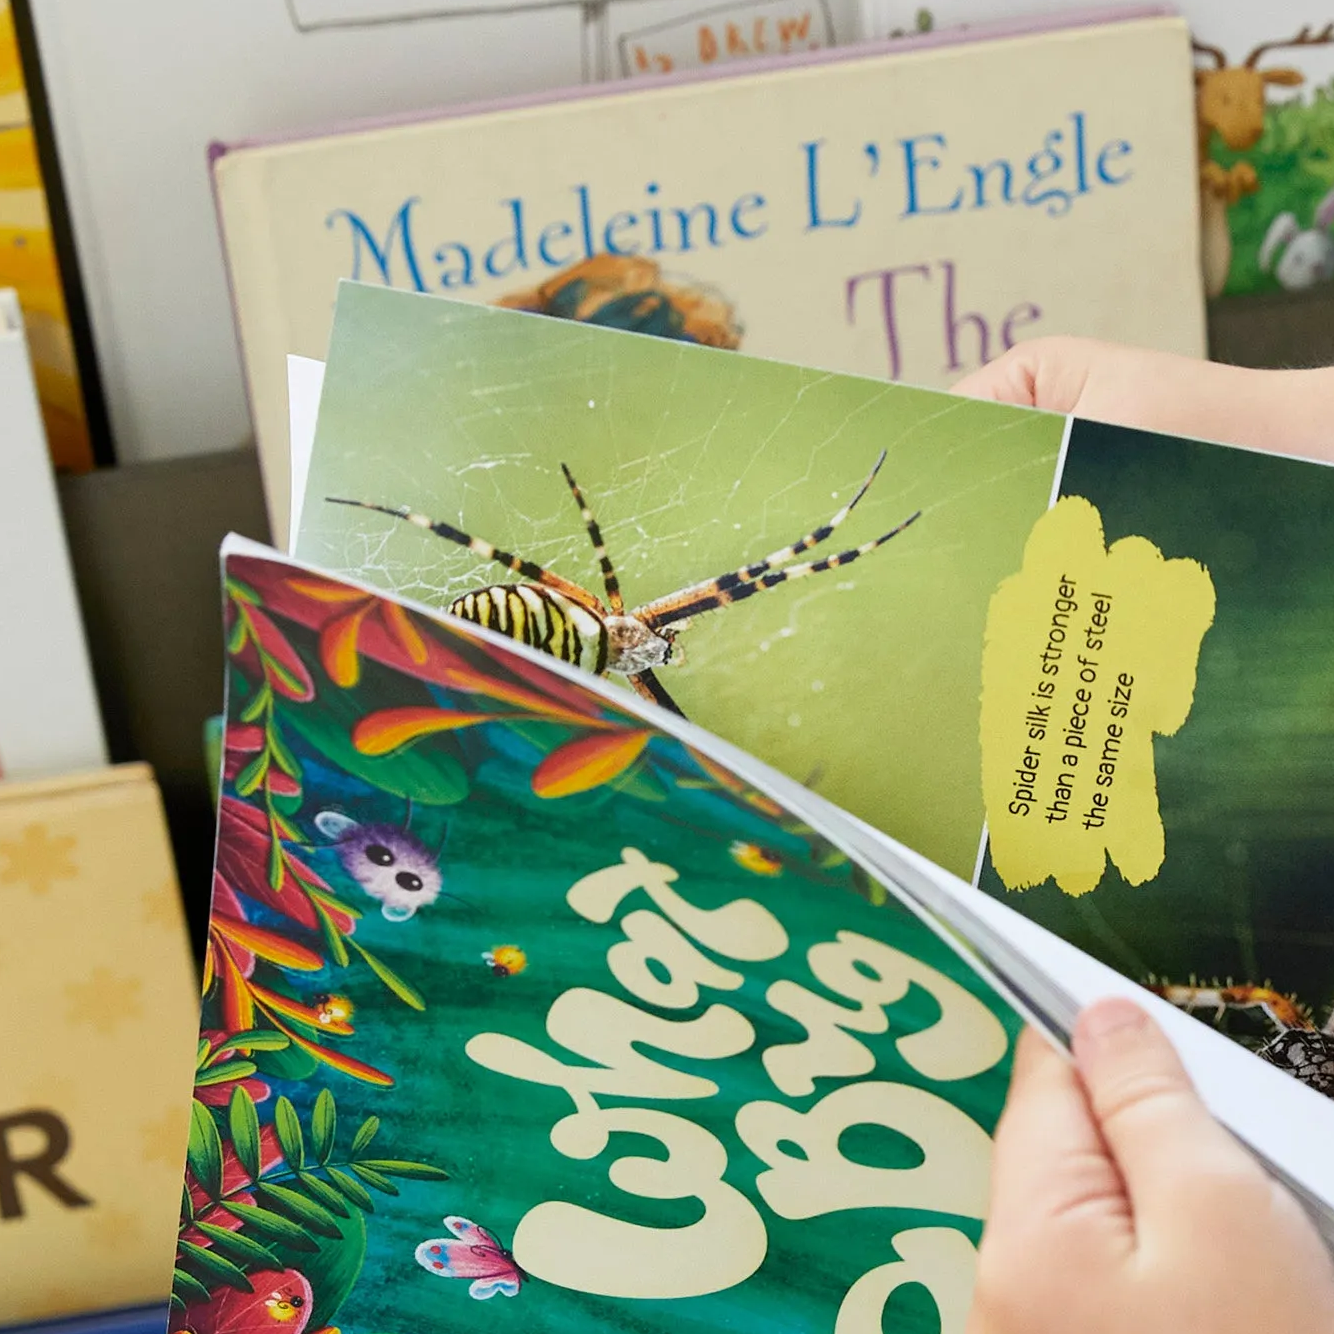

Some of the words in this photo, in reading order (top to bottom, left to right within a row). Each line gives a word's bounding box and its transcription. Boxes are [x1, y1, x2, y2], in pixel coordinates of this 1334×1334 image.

[326, 179, 769, 295] Madeleine
[800, 111, 1135, 234] L'Engle
[845, 260, 1045, 381] The
[1041, 572, 1079, 676] stronger
[1085, 591, 1113, 652] steel
[1031, 679, 1055, 703] is
[1076, 655, 1100, 684] of
[1106, 671, 1134, 719] size
[1025, 701, 1051, 742] silk
[1061, 687, 1092, 749] piece
[1008, 745, 1041, 817] Spider
[1067, 752, 1079, 768] a
[1095, 725, 1124, 788] same
[1044, 770, 1074, 825] than
[1081, 787, 1109, 831] the
[466, 846, 789, 1300] What
[734, 930, 1009, 1221] Bug
